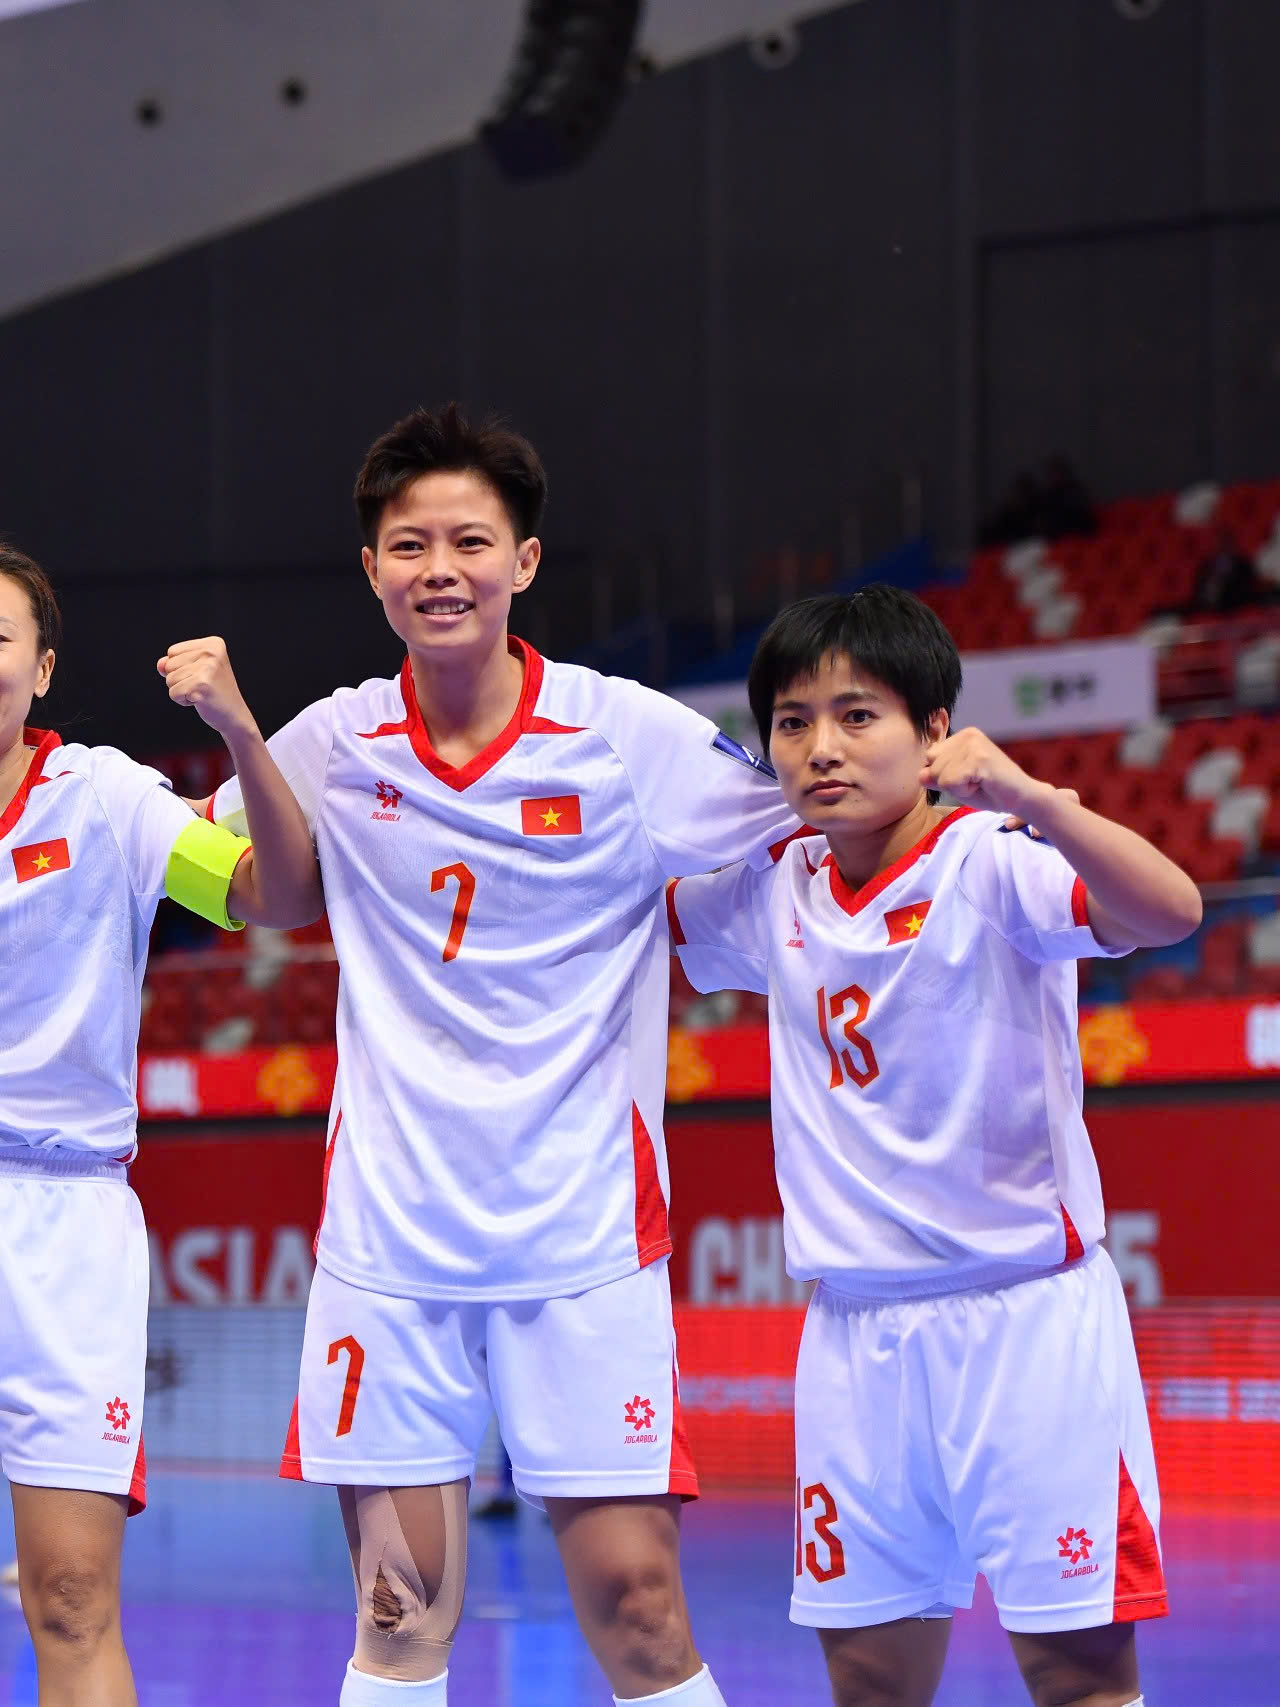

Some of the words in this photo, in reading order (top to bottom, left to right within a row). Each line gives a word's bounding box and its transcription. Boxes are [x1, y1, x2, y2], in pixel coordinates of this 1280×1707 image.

[430, 862, 476, 963] 7
[816, 983, 880, 1090] 13
[327, 1335, 365, 1437] 7
[796, 1476, 846, 1583] 13
